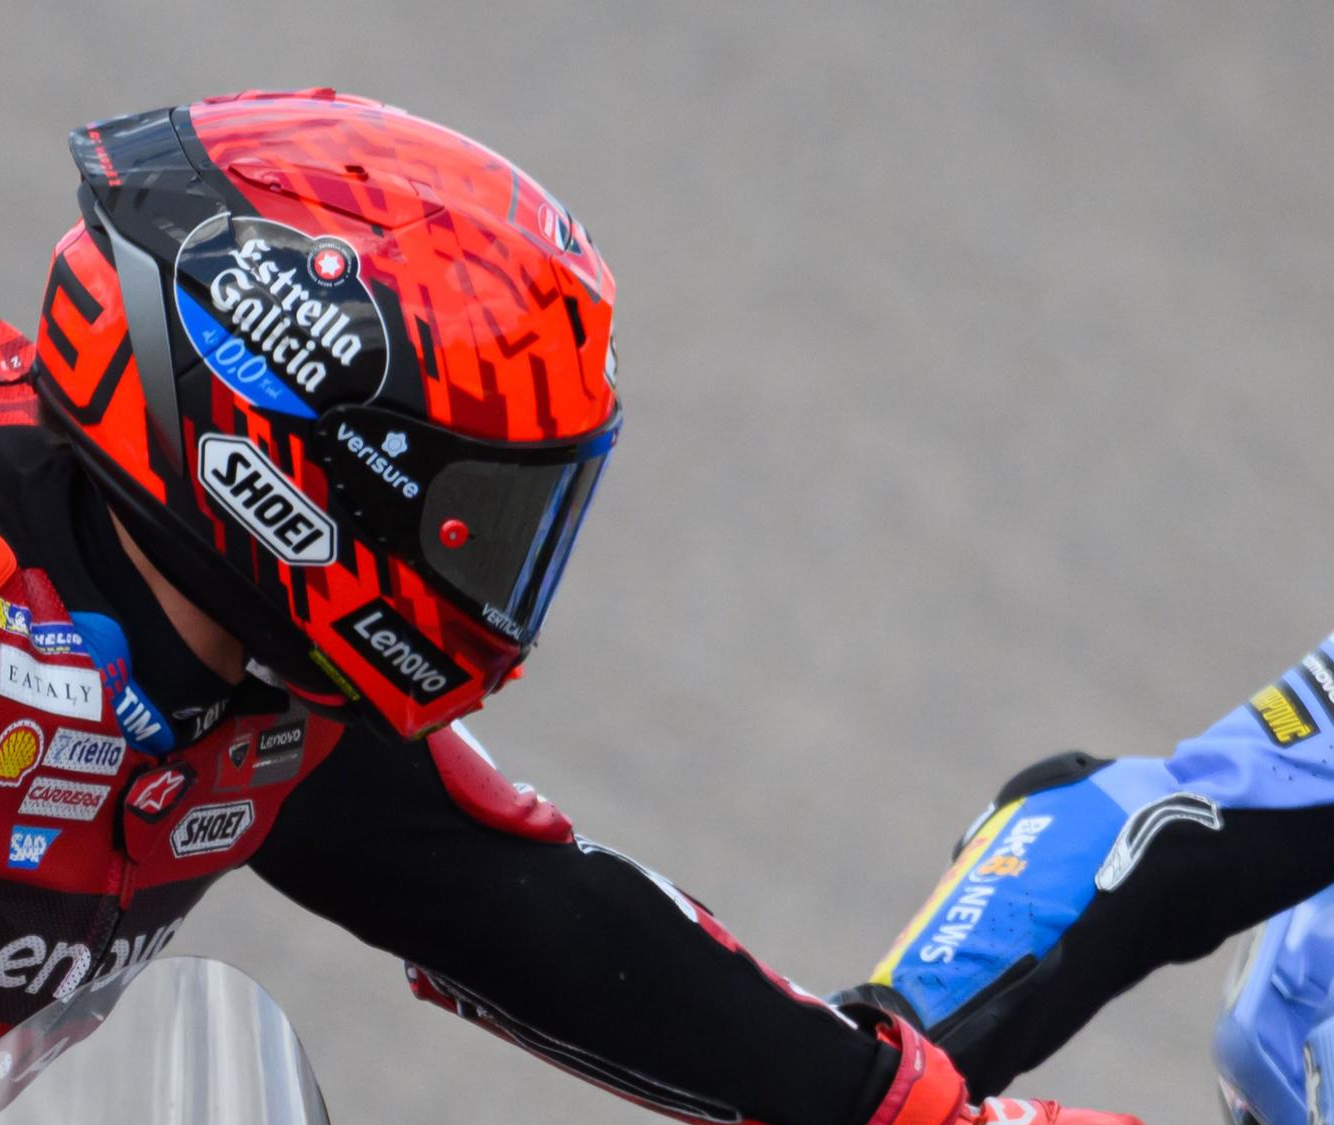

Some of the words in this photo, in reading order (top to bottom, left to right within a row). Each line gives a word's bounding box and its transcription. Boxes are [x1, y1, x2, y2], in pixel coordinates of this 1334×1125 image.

[210, 268, 327, 393] Galicia
[228, 238, 362, 367] Estrella
[215, 337, 267, 384] 0,0
[337, 422, 420, 498] verisure
[211, 450, 323, 556] SHOEI
[31, 629, 83, 648] HELIN
[353, 611, 447, 692] Lenovo
[8, 664, 94, 704] EATALY
[115, 687, 162, 742] TIM
[259, 727, 302, 752] Lenovo
[181, 810, 245, 846] SHOEI
[919, 886, 996, 964] NEWS
